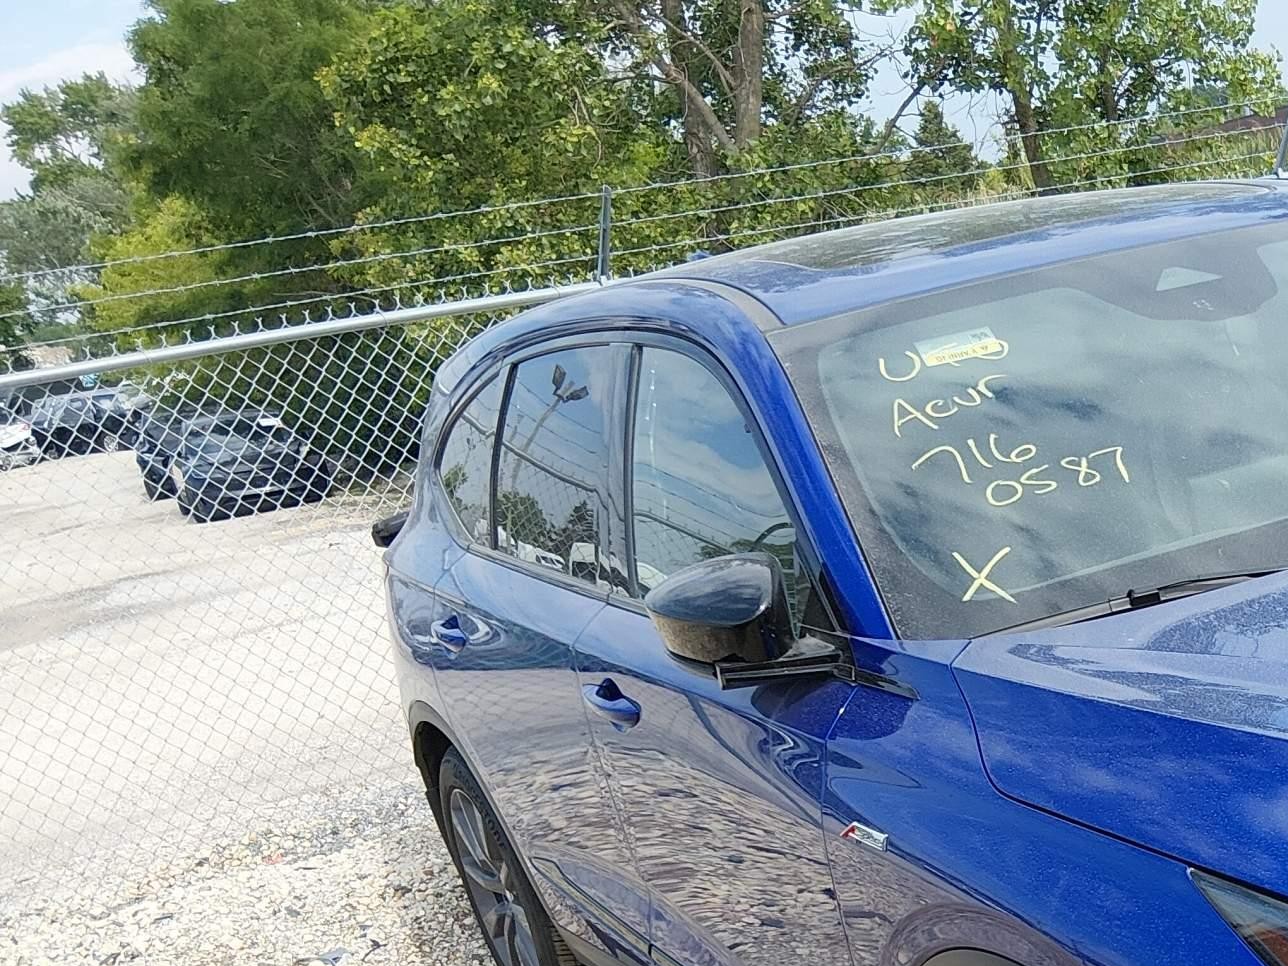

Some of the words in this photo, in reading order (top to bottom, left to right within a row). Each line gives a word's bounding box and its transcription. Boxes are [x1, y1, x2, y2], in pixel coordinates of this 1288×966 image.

[891, 373, 1008, 438] Acur
[911, 432, 1037, 484] 716
[984, 446, 1131, 506] 0587
[951, 546, 1018, 604] X
